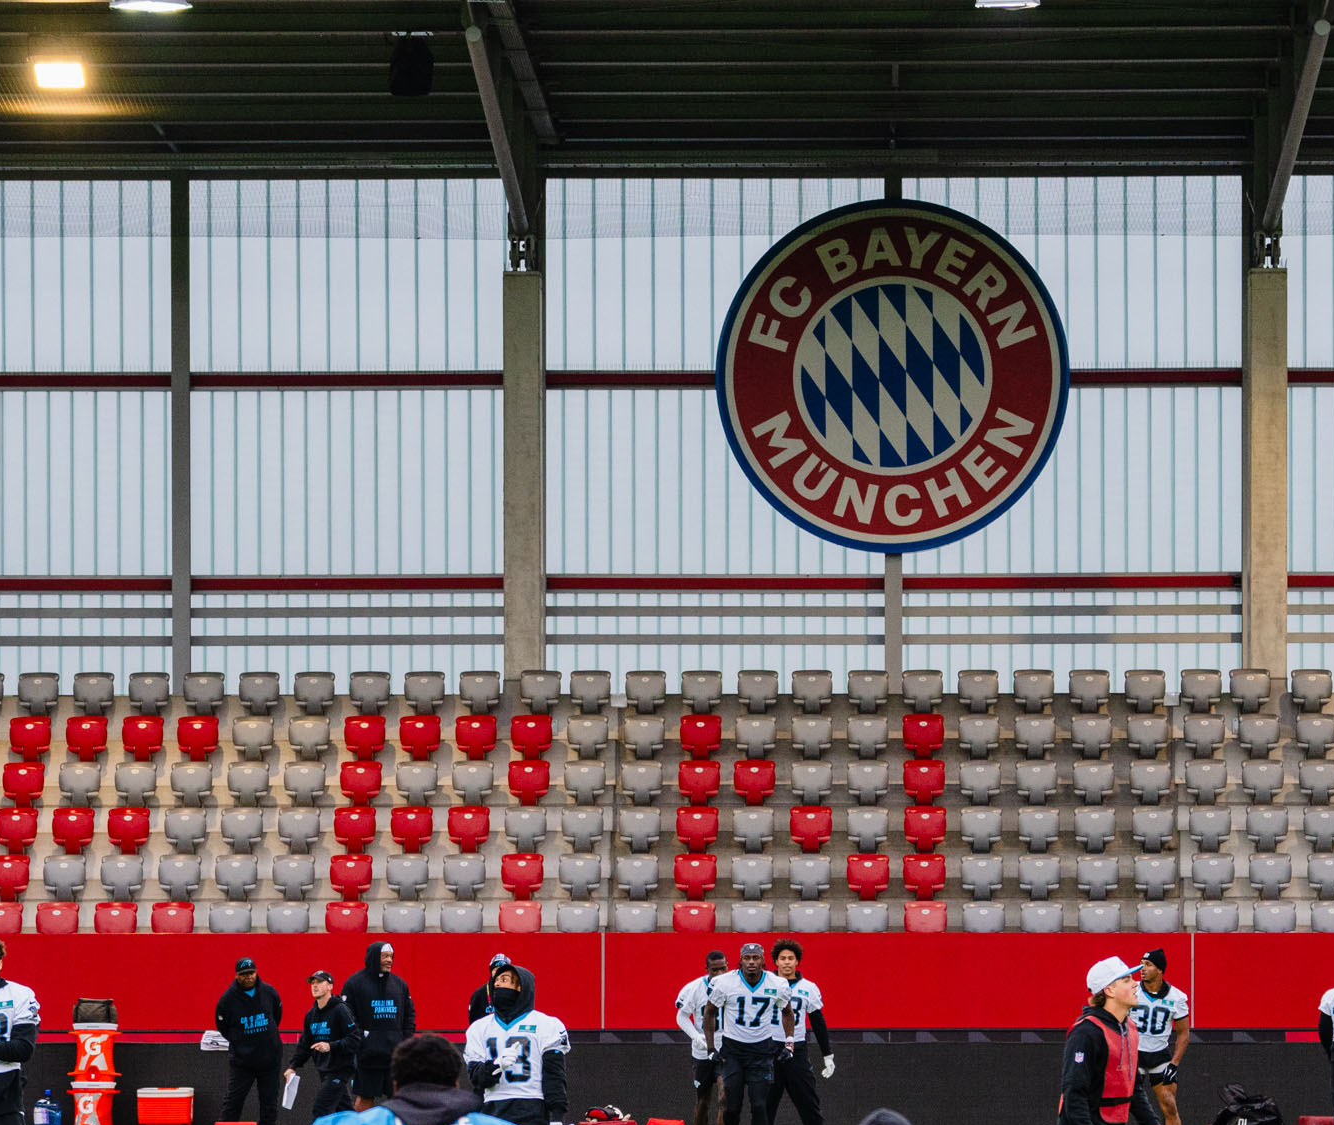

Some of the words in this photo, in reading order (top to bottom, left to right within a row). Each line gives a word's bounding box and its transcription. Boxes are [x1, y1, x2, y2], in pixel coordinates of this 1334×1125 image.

[748, 276, 812, 353] FC
[815, 226, 1038, 350] BAYERN
[752, 407, 1036, 527] MÜNCHEN
[735, 996, 771, 1027] 17
[1131, 1004, 1171, 1035] 30
[85, 1037, 102, 1055] G
[486, 1036, 531, 1083] 13
[78, 1096, 94, 1114] G
